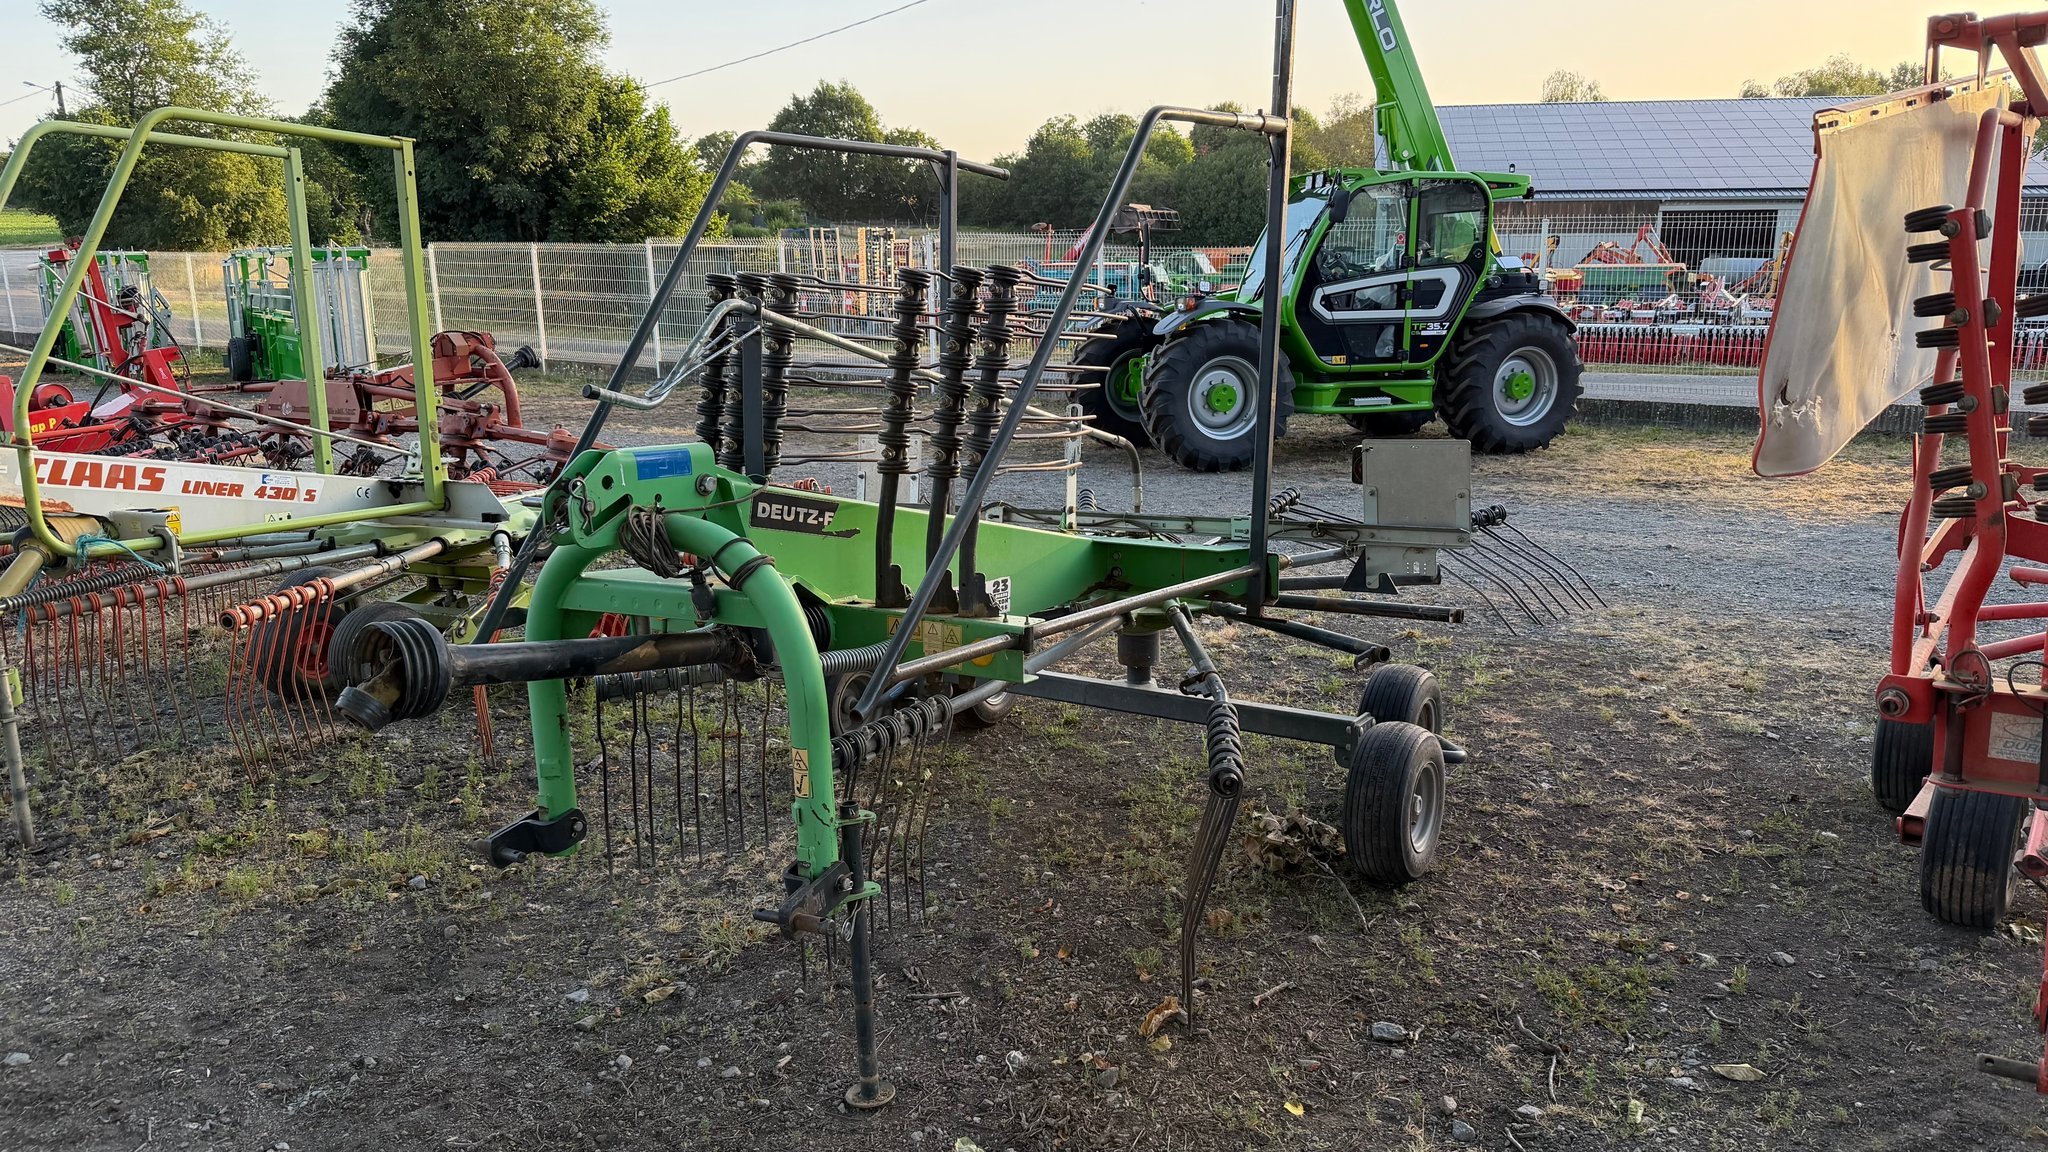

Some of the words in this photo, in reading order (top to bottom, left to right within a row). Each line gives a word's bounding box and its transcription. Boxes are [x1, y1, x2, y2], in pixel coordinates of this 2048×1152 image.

[31, 423, 46, 433] ap
[48, 417, 57, 429] P
[181, 480, 244, 498] LINER
[254, 485, 298, 501] 430
[303, 488, 317, 502] S
[757, 501, 834, 526] DEUTZ-F
[992, 578, 1009, 594] 23
